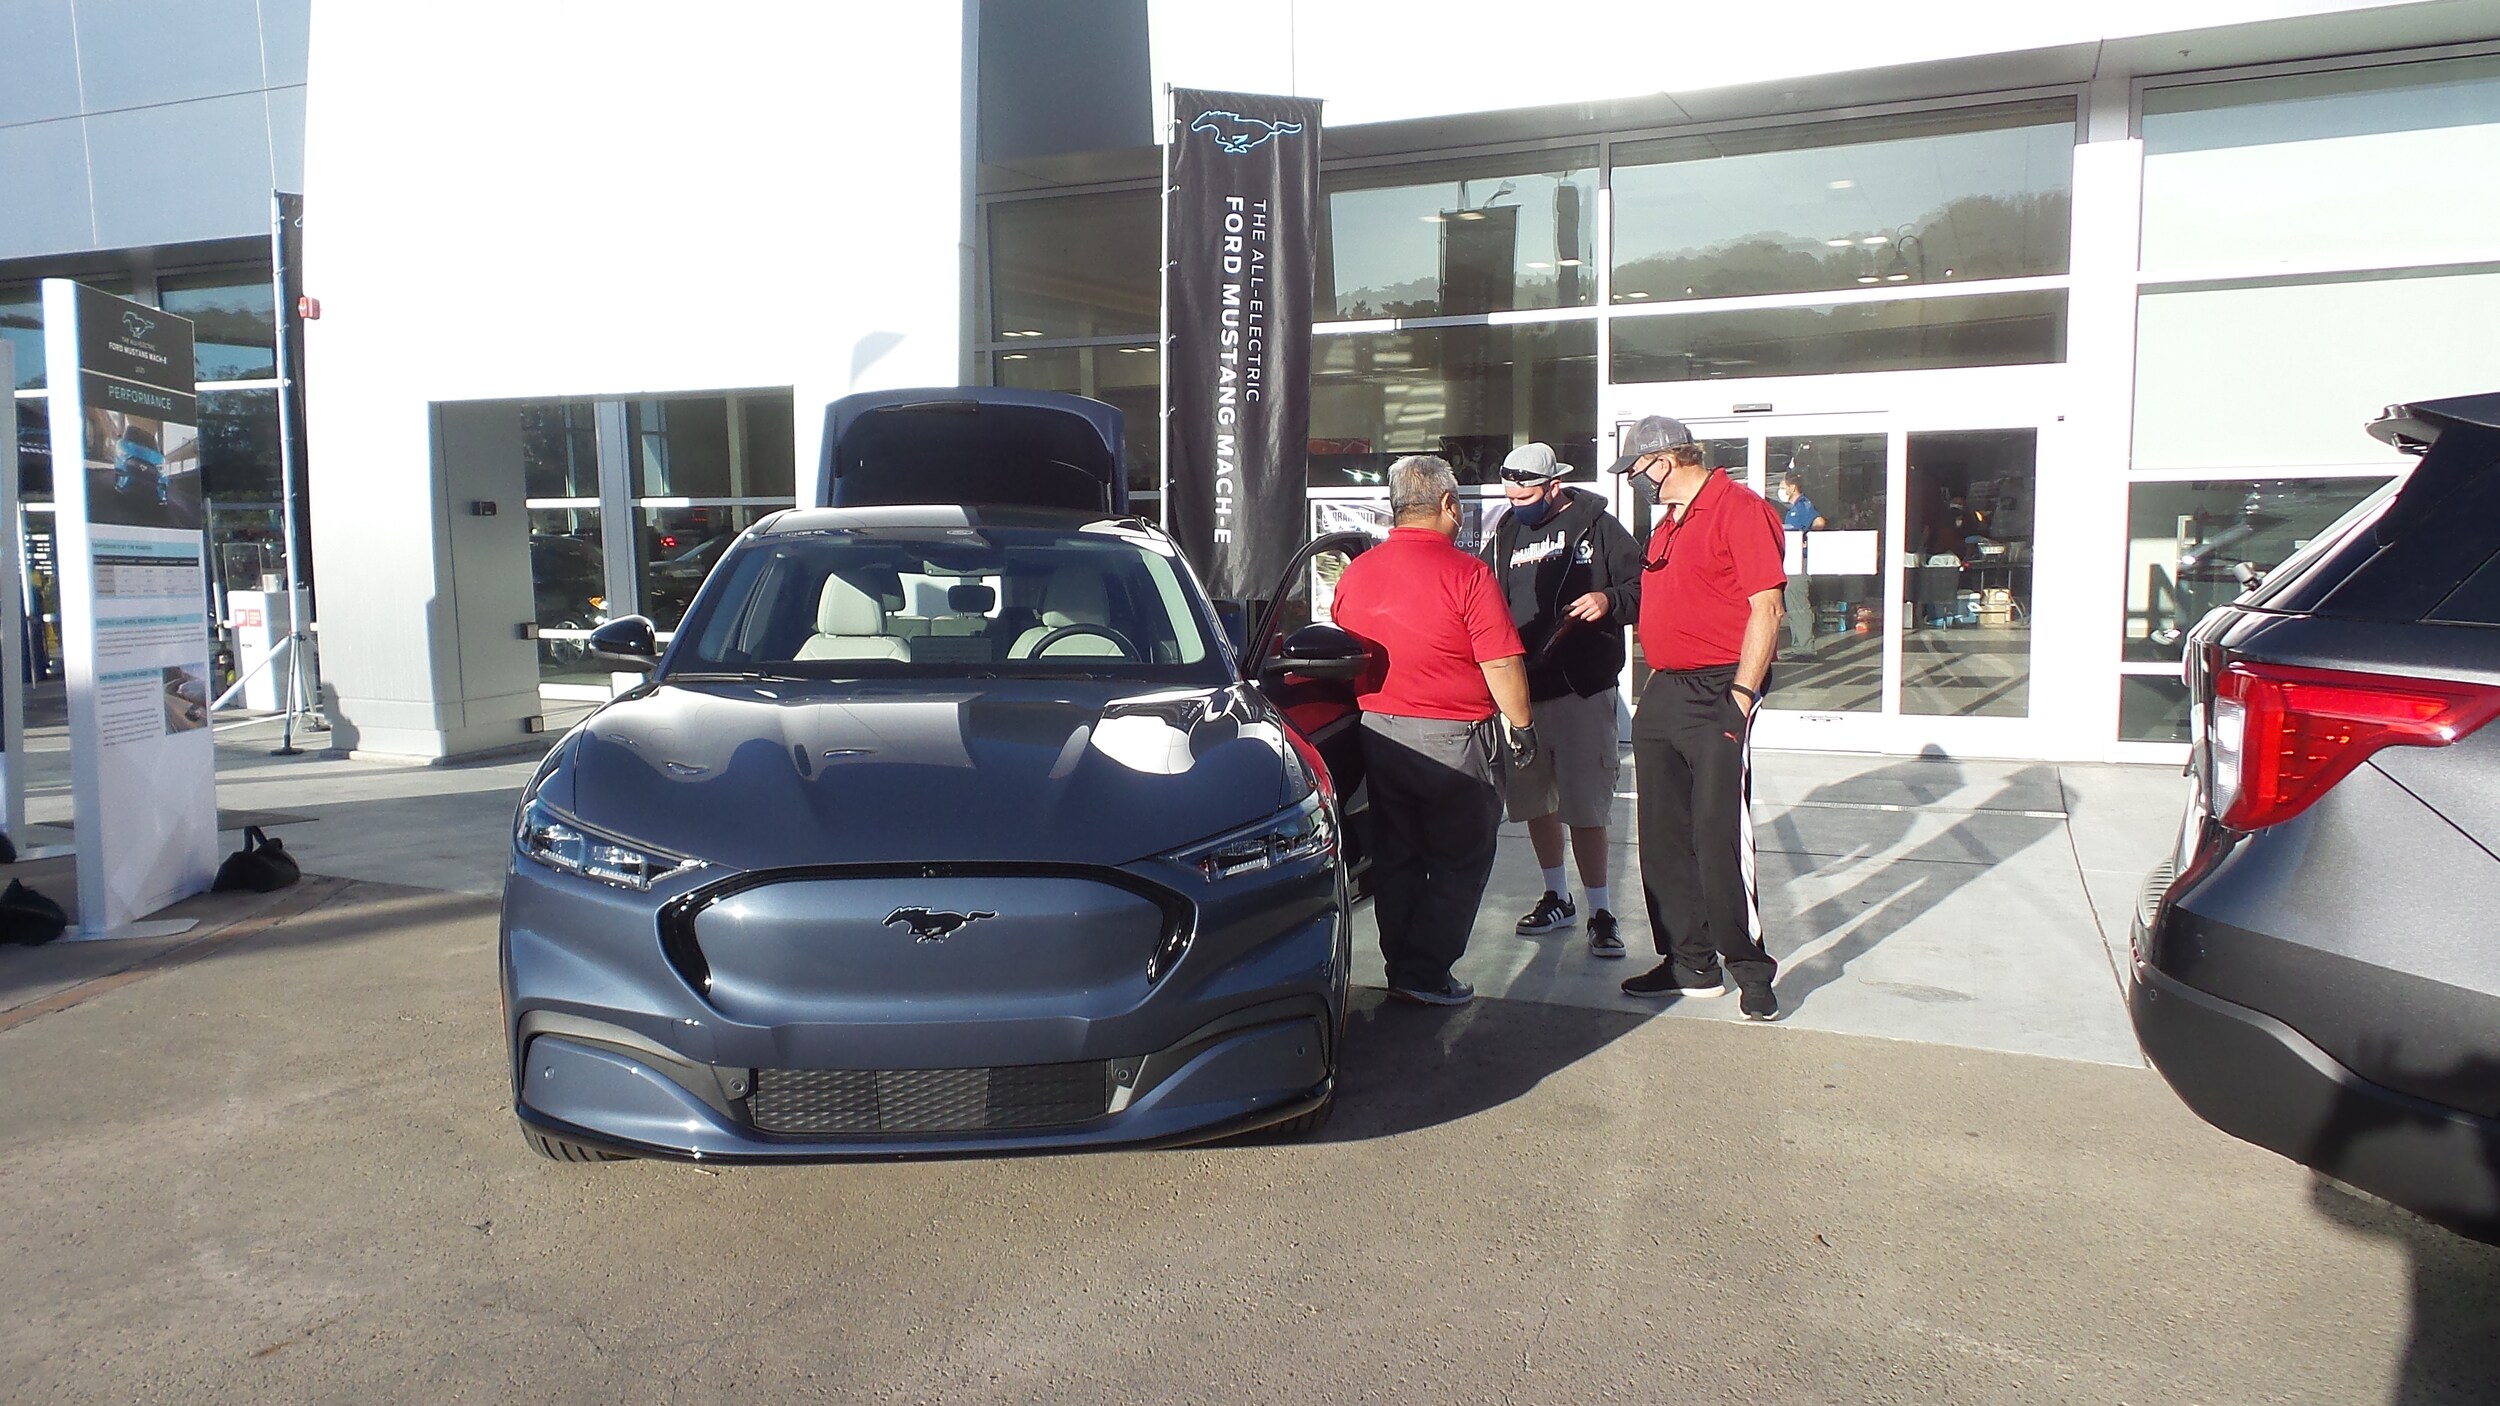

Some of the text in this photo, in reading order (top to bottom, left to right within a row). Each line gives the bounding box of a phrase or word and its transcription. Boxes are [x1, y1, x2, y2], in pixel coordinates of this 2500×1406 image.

[108, 341, 124, 352] FORD
[124, 346, 149, 359] MUSTANG
[1245, 199, 1267, 402] THE ALL-ELECTRIC
[108, 385, 172, 410] PERFORMANCE
[1213, 196, 1244, 544] FORD MUSTANG MACH-E
